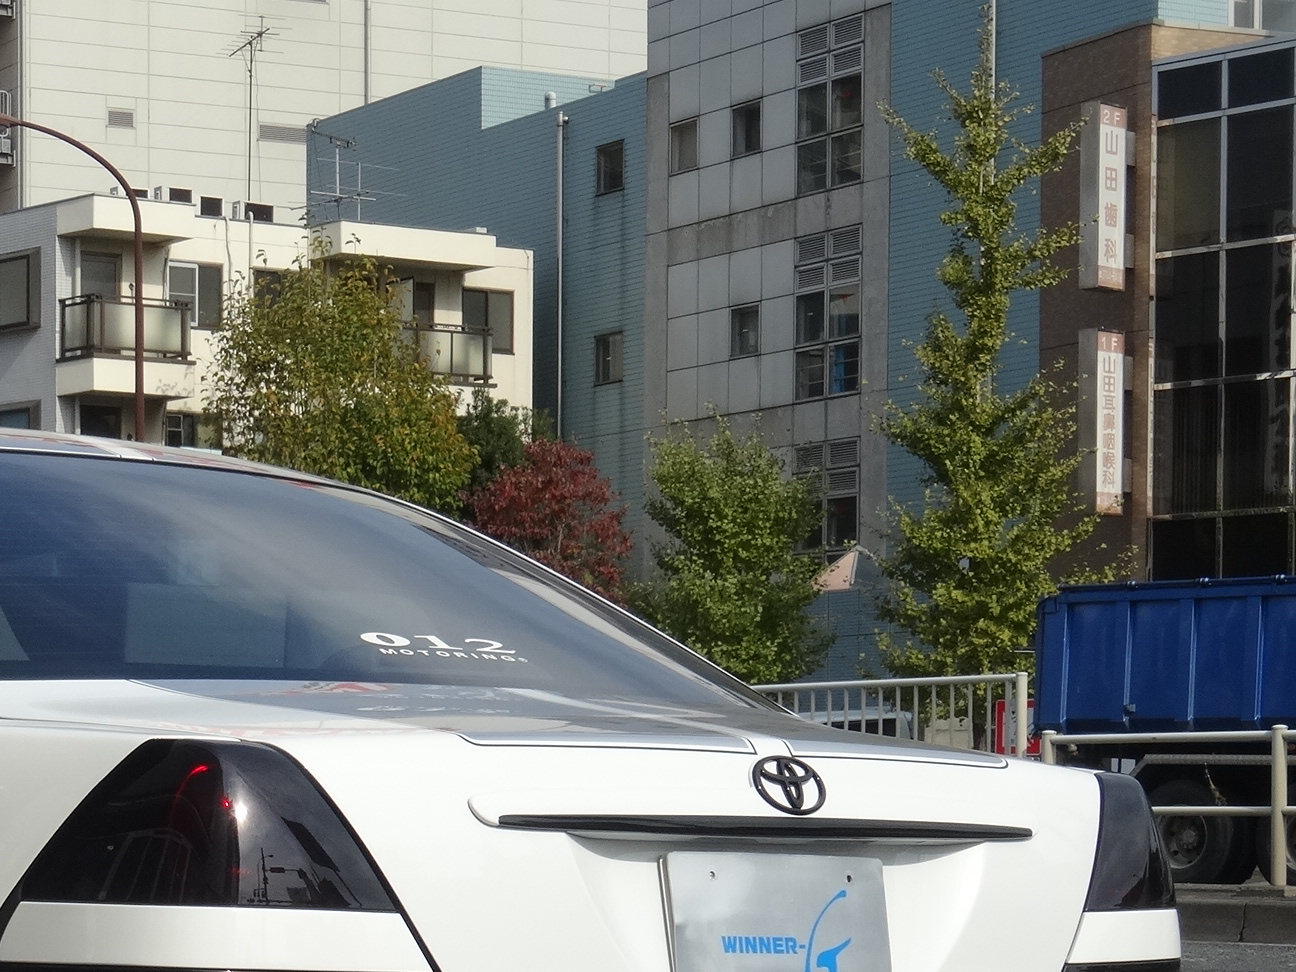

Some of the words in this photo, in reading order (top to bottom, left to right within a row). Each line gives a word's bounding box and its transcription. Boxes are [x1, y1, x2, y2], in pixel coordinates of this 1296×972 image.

[1103, 109, 1121, 125] 2F
[1103, 130, 1120, 265] 山田歯科
[1101, 335, 1119, 350] 1F
[1102, 355, 1117, 490] 山田耳鼻咽喉科
[359, 632, 516, 655] 012
[379, 648, 516, 662] MOTORING
